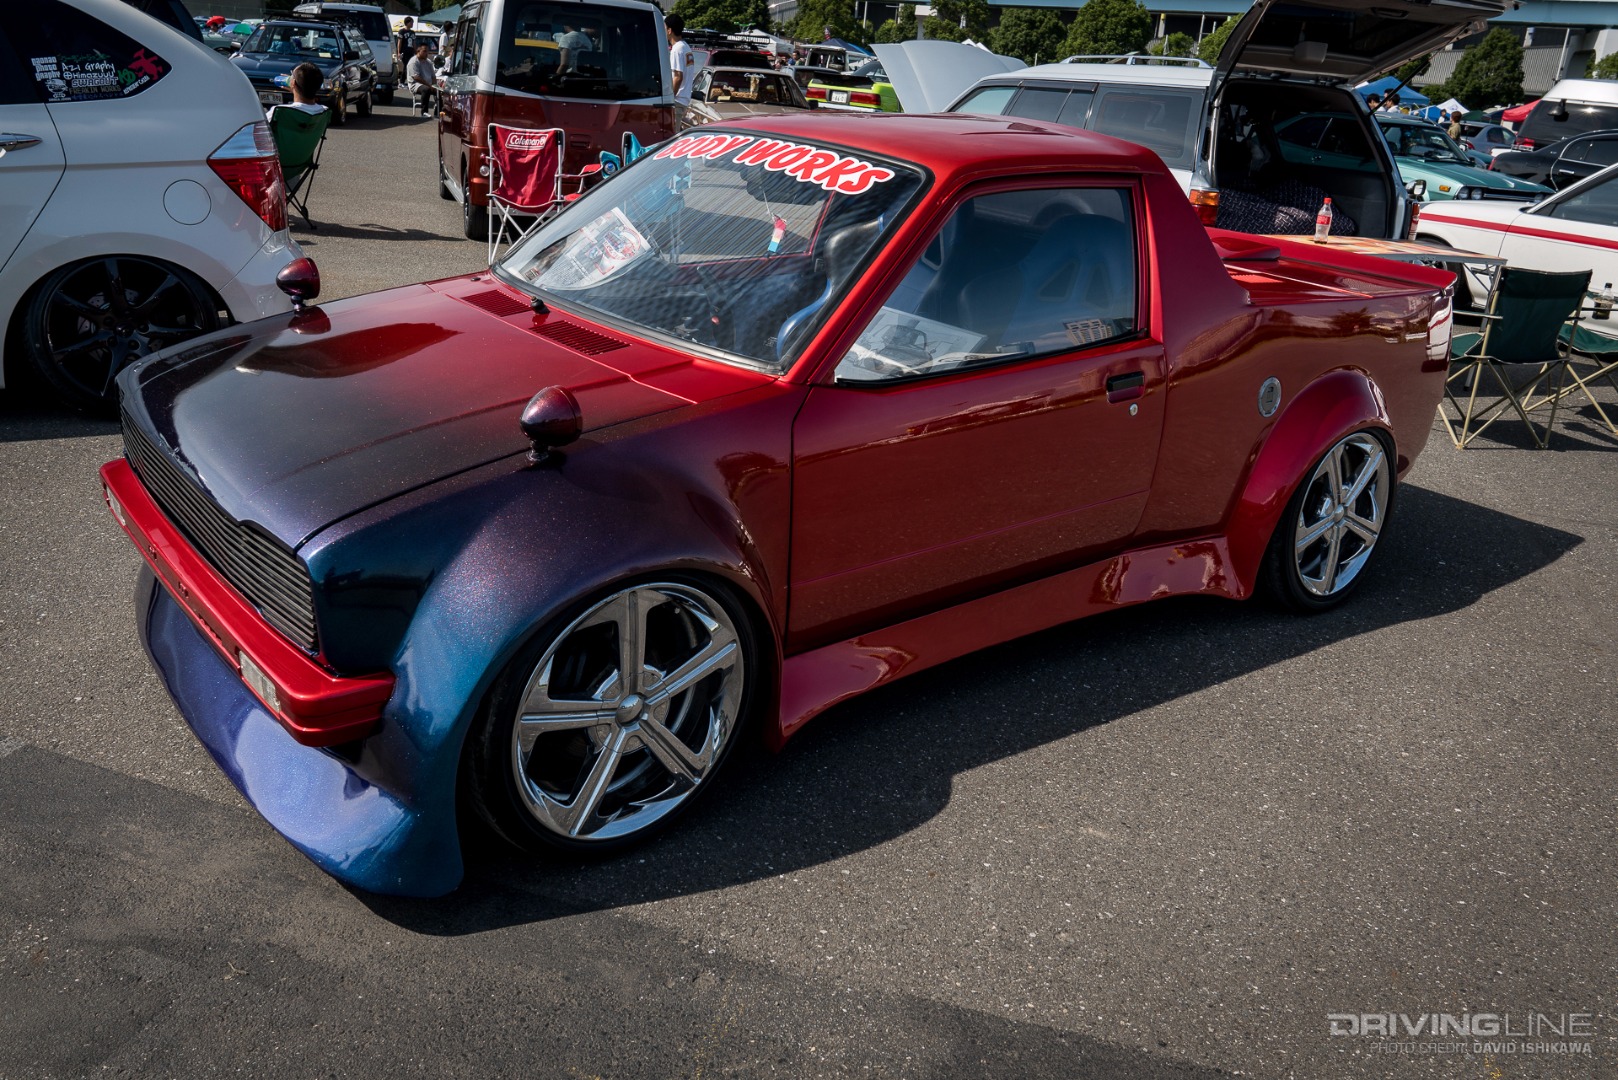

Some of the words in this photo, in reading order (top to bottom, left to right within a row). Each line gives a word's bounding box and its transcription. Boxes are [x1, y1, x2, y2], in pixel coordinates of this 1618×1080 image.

[510, 134, 541, 146] Coleman
[653, 134, 755, 161] BODY
[732, 137, 896, 195] WORKS
